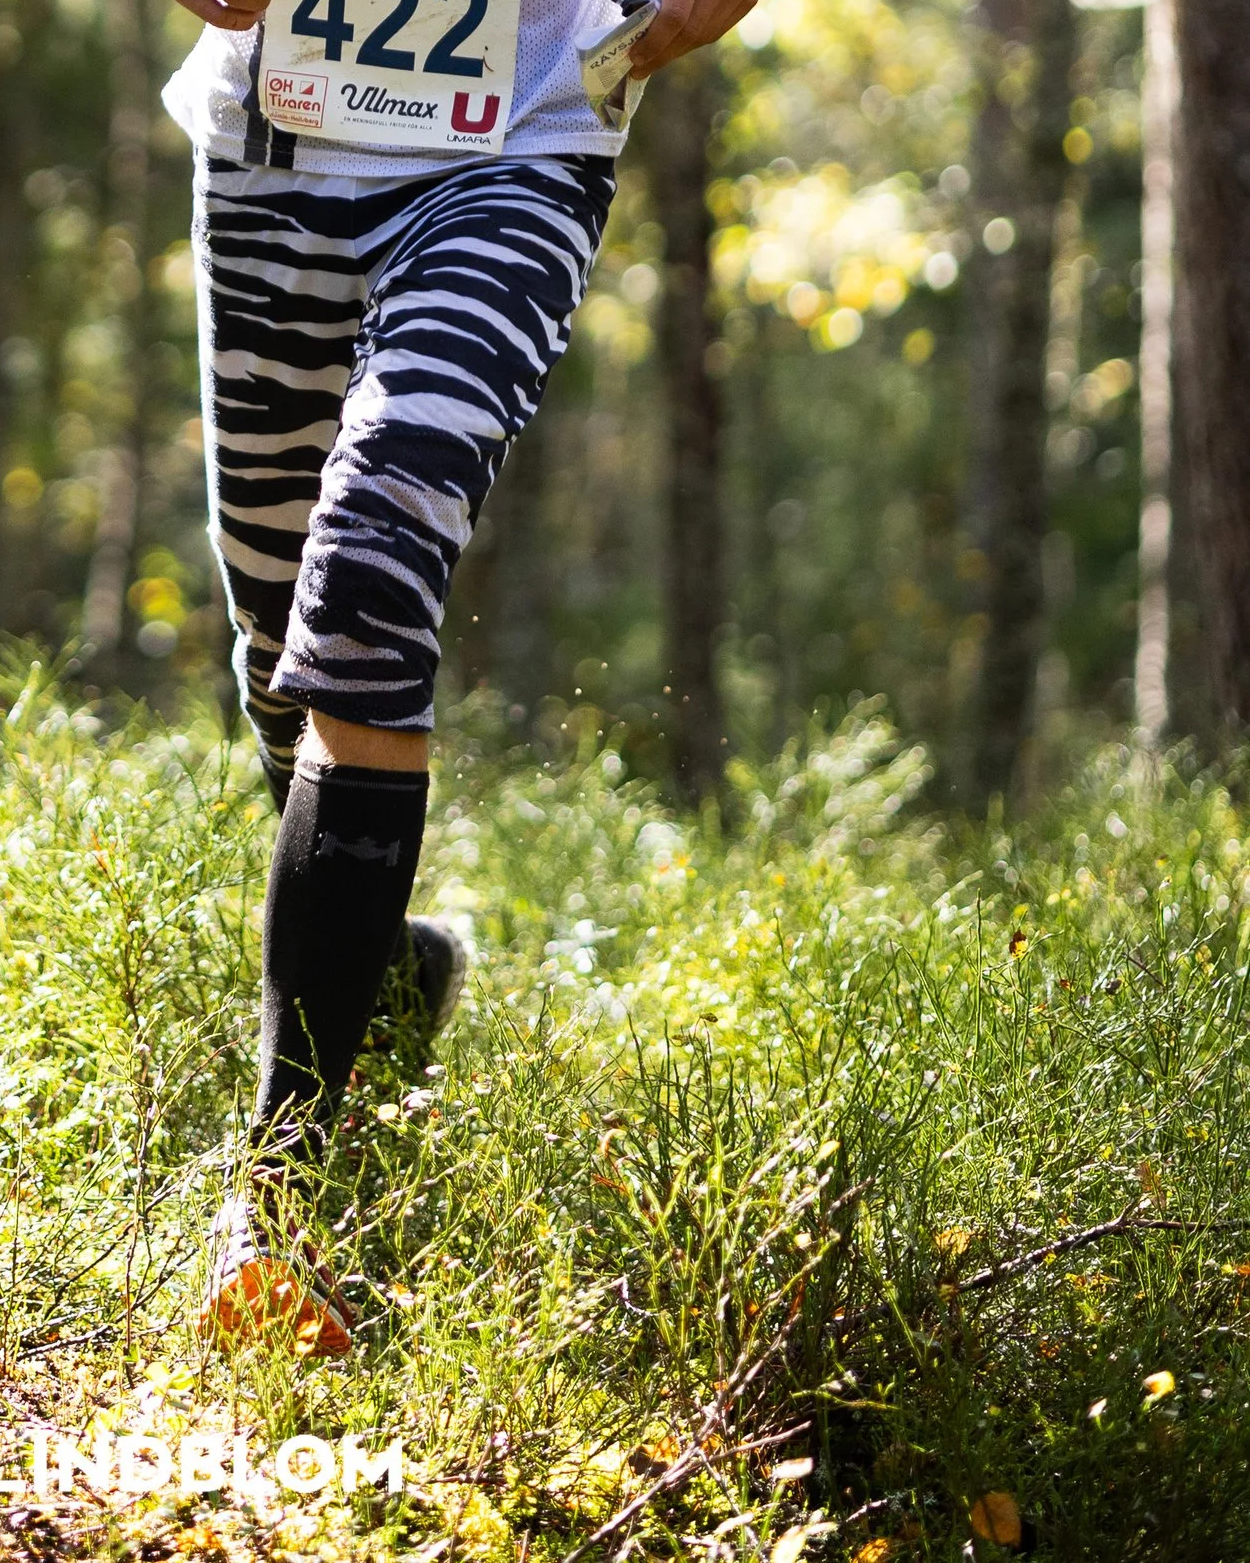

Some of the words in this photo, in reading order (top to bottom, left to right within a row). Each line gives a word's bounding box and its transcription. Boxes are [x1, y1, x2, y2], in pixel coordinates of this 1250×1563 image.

[269, 93, 321, 112] Tisaren
[341, 83, 438, 119] Ullmax
[446, 134, 491, 145] UMARA
